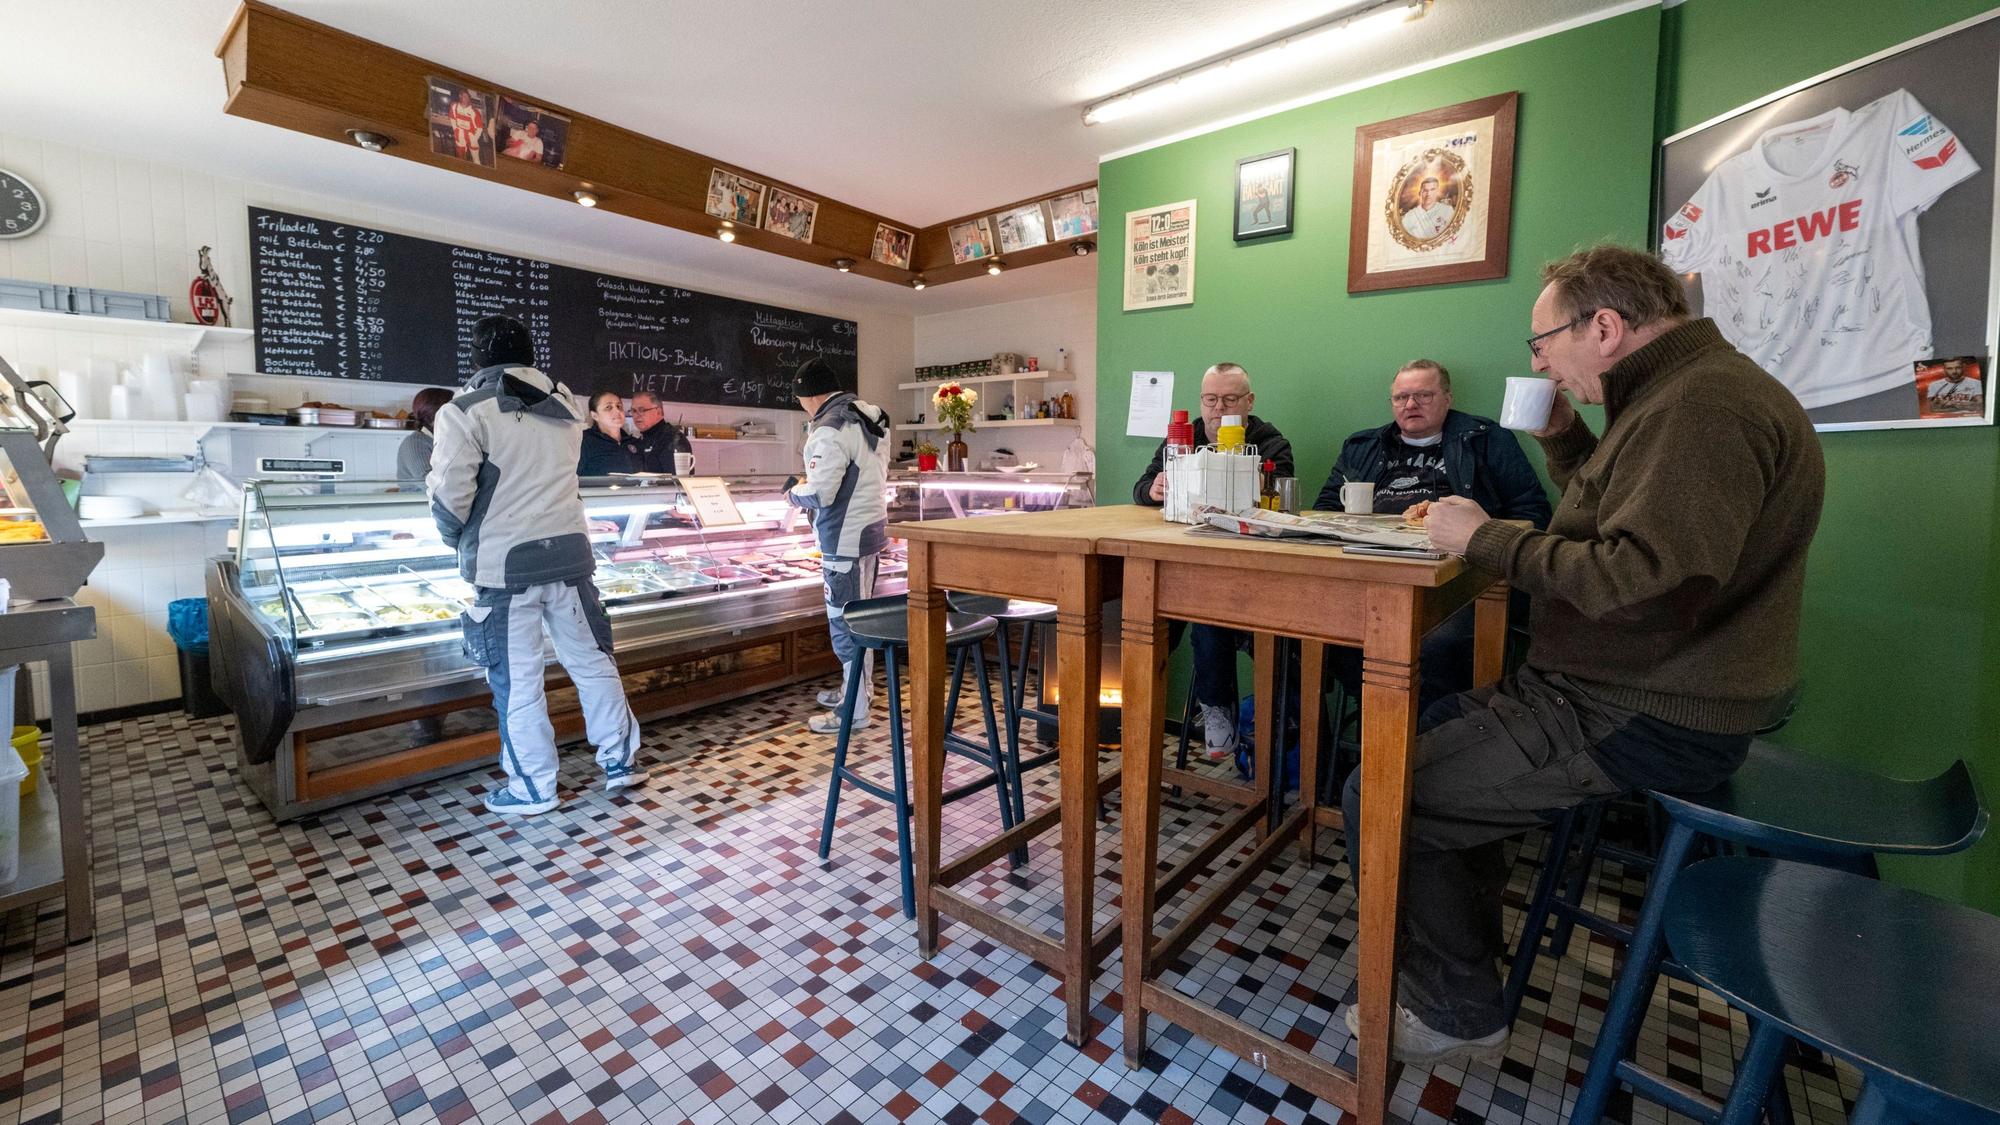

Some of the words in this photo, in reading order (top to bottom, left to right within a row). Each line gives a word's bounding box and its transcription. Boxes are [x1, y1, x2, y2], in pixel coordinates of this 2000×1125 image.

[1906, 128, 1946, 155] Hermes
[1, 179, 8, 189] 1
[12, 189, 25, 199] 2
[20, 201, 33, 211] 3
[1750, 196, 1777, 209] erima
[17, 212, 29, 221] 4
[5, 219, 18, 229] 5
[257, 216, 320, 235] Frikadelle
[332, 226, 345, 238] €
[1747, 199, 1863, 258] REWE
[259, 235, 280, 246] mit
[287, 236, 334, 250] Brötchen
[1134, 241, 1149, 252] Köln
[1149, 240, 1159, 249] ist
[1160, 233, 1189, 248] Meister!
[259, 246, 304, 259] Schnitzel
[452, 247, 483, 260] Gulasch
[487, 253, 510, 265] Suppe
[1134, 254, 1149, 265] Köln
[1150, 251, 1169, 263] steht
[260, 258, 277, 266] mit
[280, 259, 322, 270] Brötchen
[260, 268, 294, 278] Cordon
[298, 272, 322, 281] Bleu
[493, 266, 512, 276] Carne
[282, 279, 326, 290] Brötchen
[260, 287, 317, 299] Fleischkäse
[282, 299, 323, 309] Brötchen
[282, 317, 324, 326] Brötchen
[282, 336, 325, 345] Brötchen
[264, 357, 316, 368] Bockwurst
[632, 372, 687, 393] METT
[723, 378, 737, 393] €
